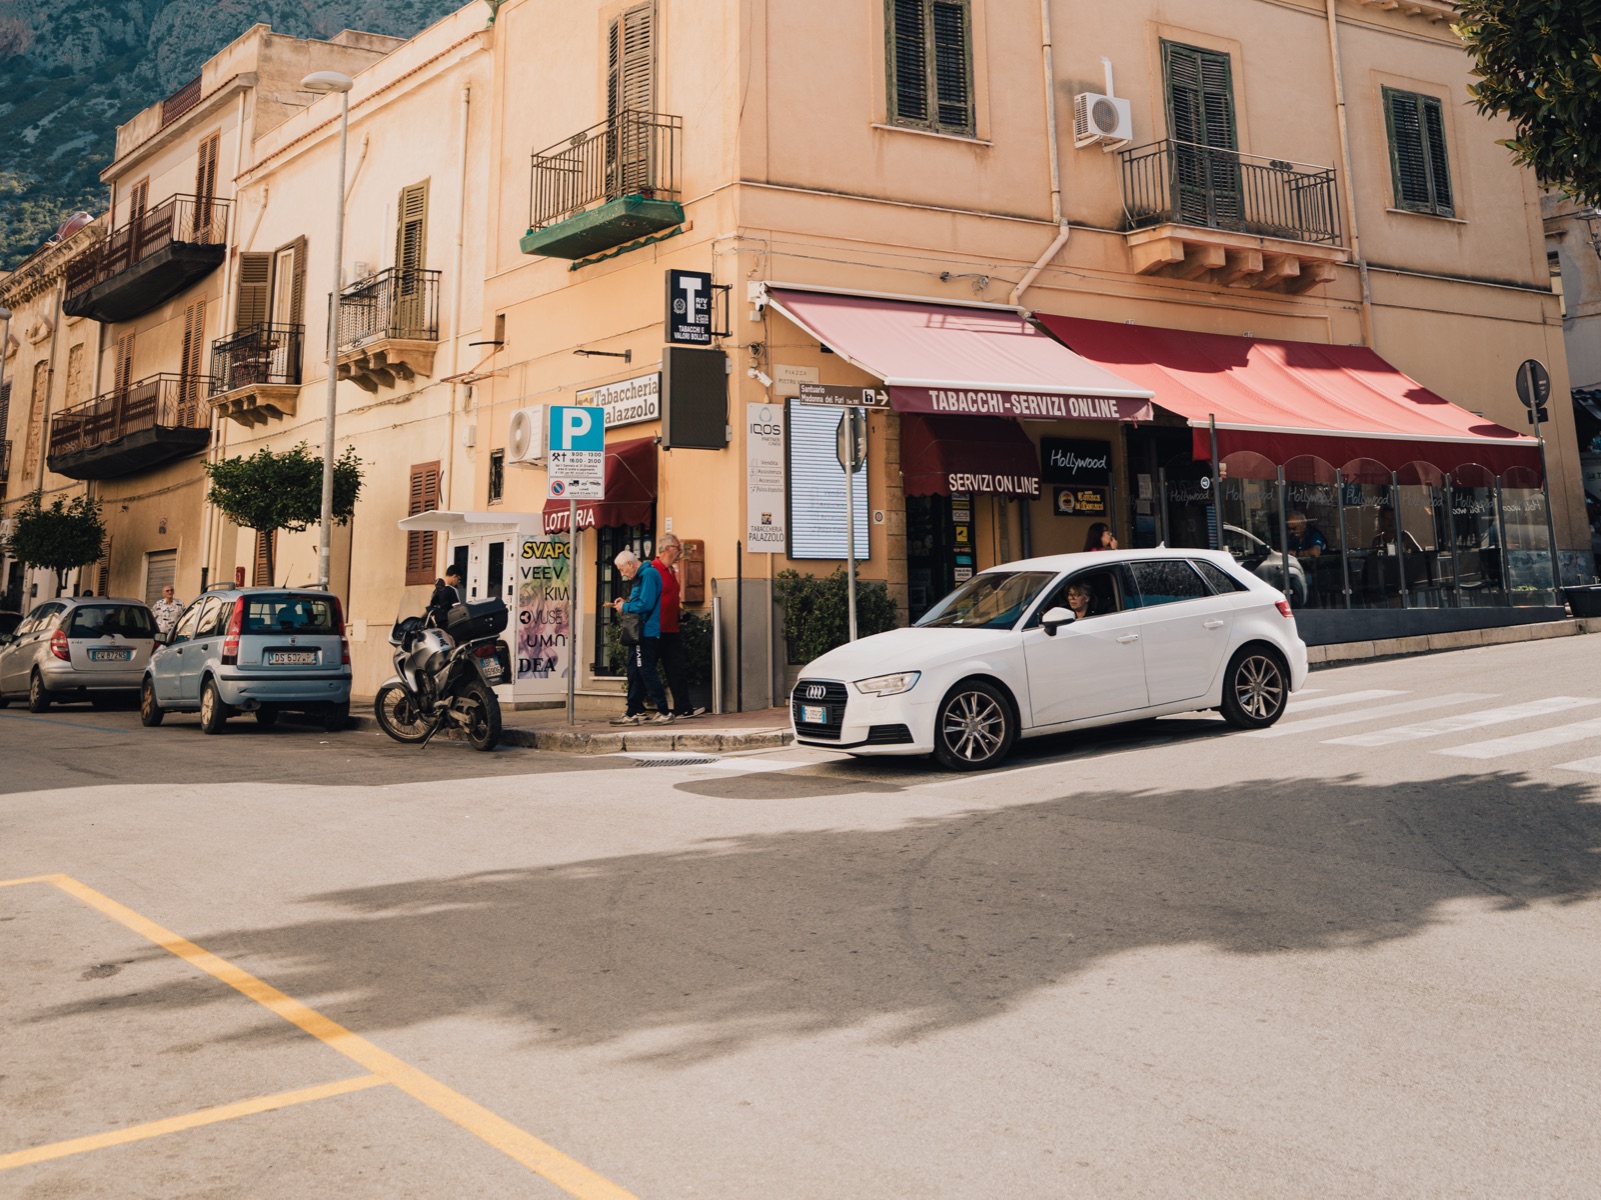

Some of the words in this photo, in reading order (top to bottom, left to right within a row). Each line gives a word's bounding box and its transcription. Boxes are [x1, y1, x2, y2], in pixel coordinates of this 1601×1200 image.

[679, 276, 702, 323] T
[673, 331, 690, 340] VALORI
[690, 333, 709, 341] BOLLATI
[678, 325, 700, 334] TABACCHI
[594, 377, 658, 407] Tabaccheria
[801, 385, 825, 394] Santuario
[801, 394, 824, 403] Madonna
[824, 395, 834, 404] del
[1069, 397, 1120, 418] ONLINE
[605, 399, 655, 424] alazzolo
[562, 408, 592, 450] P
[750, 423, 781, 436] IQOS
[1050, 449, 1107, 475] Hollywood
[948, 473, 993, 491] SERVIZI
[995, 475, 1013, 492] ON
[1014, 476, 1039, 495] LINE
[1170, 488, 1209, 507] Hollywood
[545, 508, 595, 531] LOTTRIA
[749, 532, 784, 542] PALAZZOLO
[750, 525, 783, 533] TABACCHERIA
[520, 566, 564, 580] VEEV
[531, 610, 563, 625] VUSE
[519, 657, 556, 674] DEA
